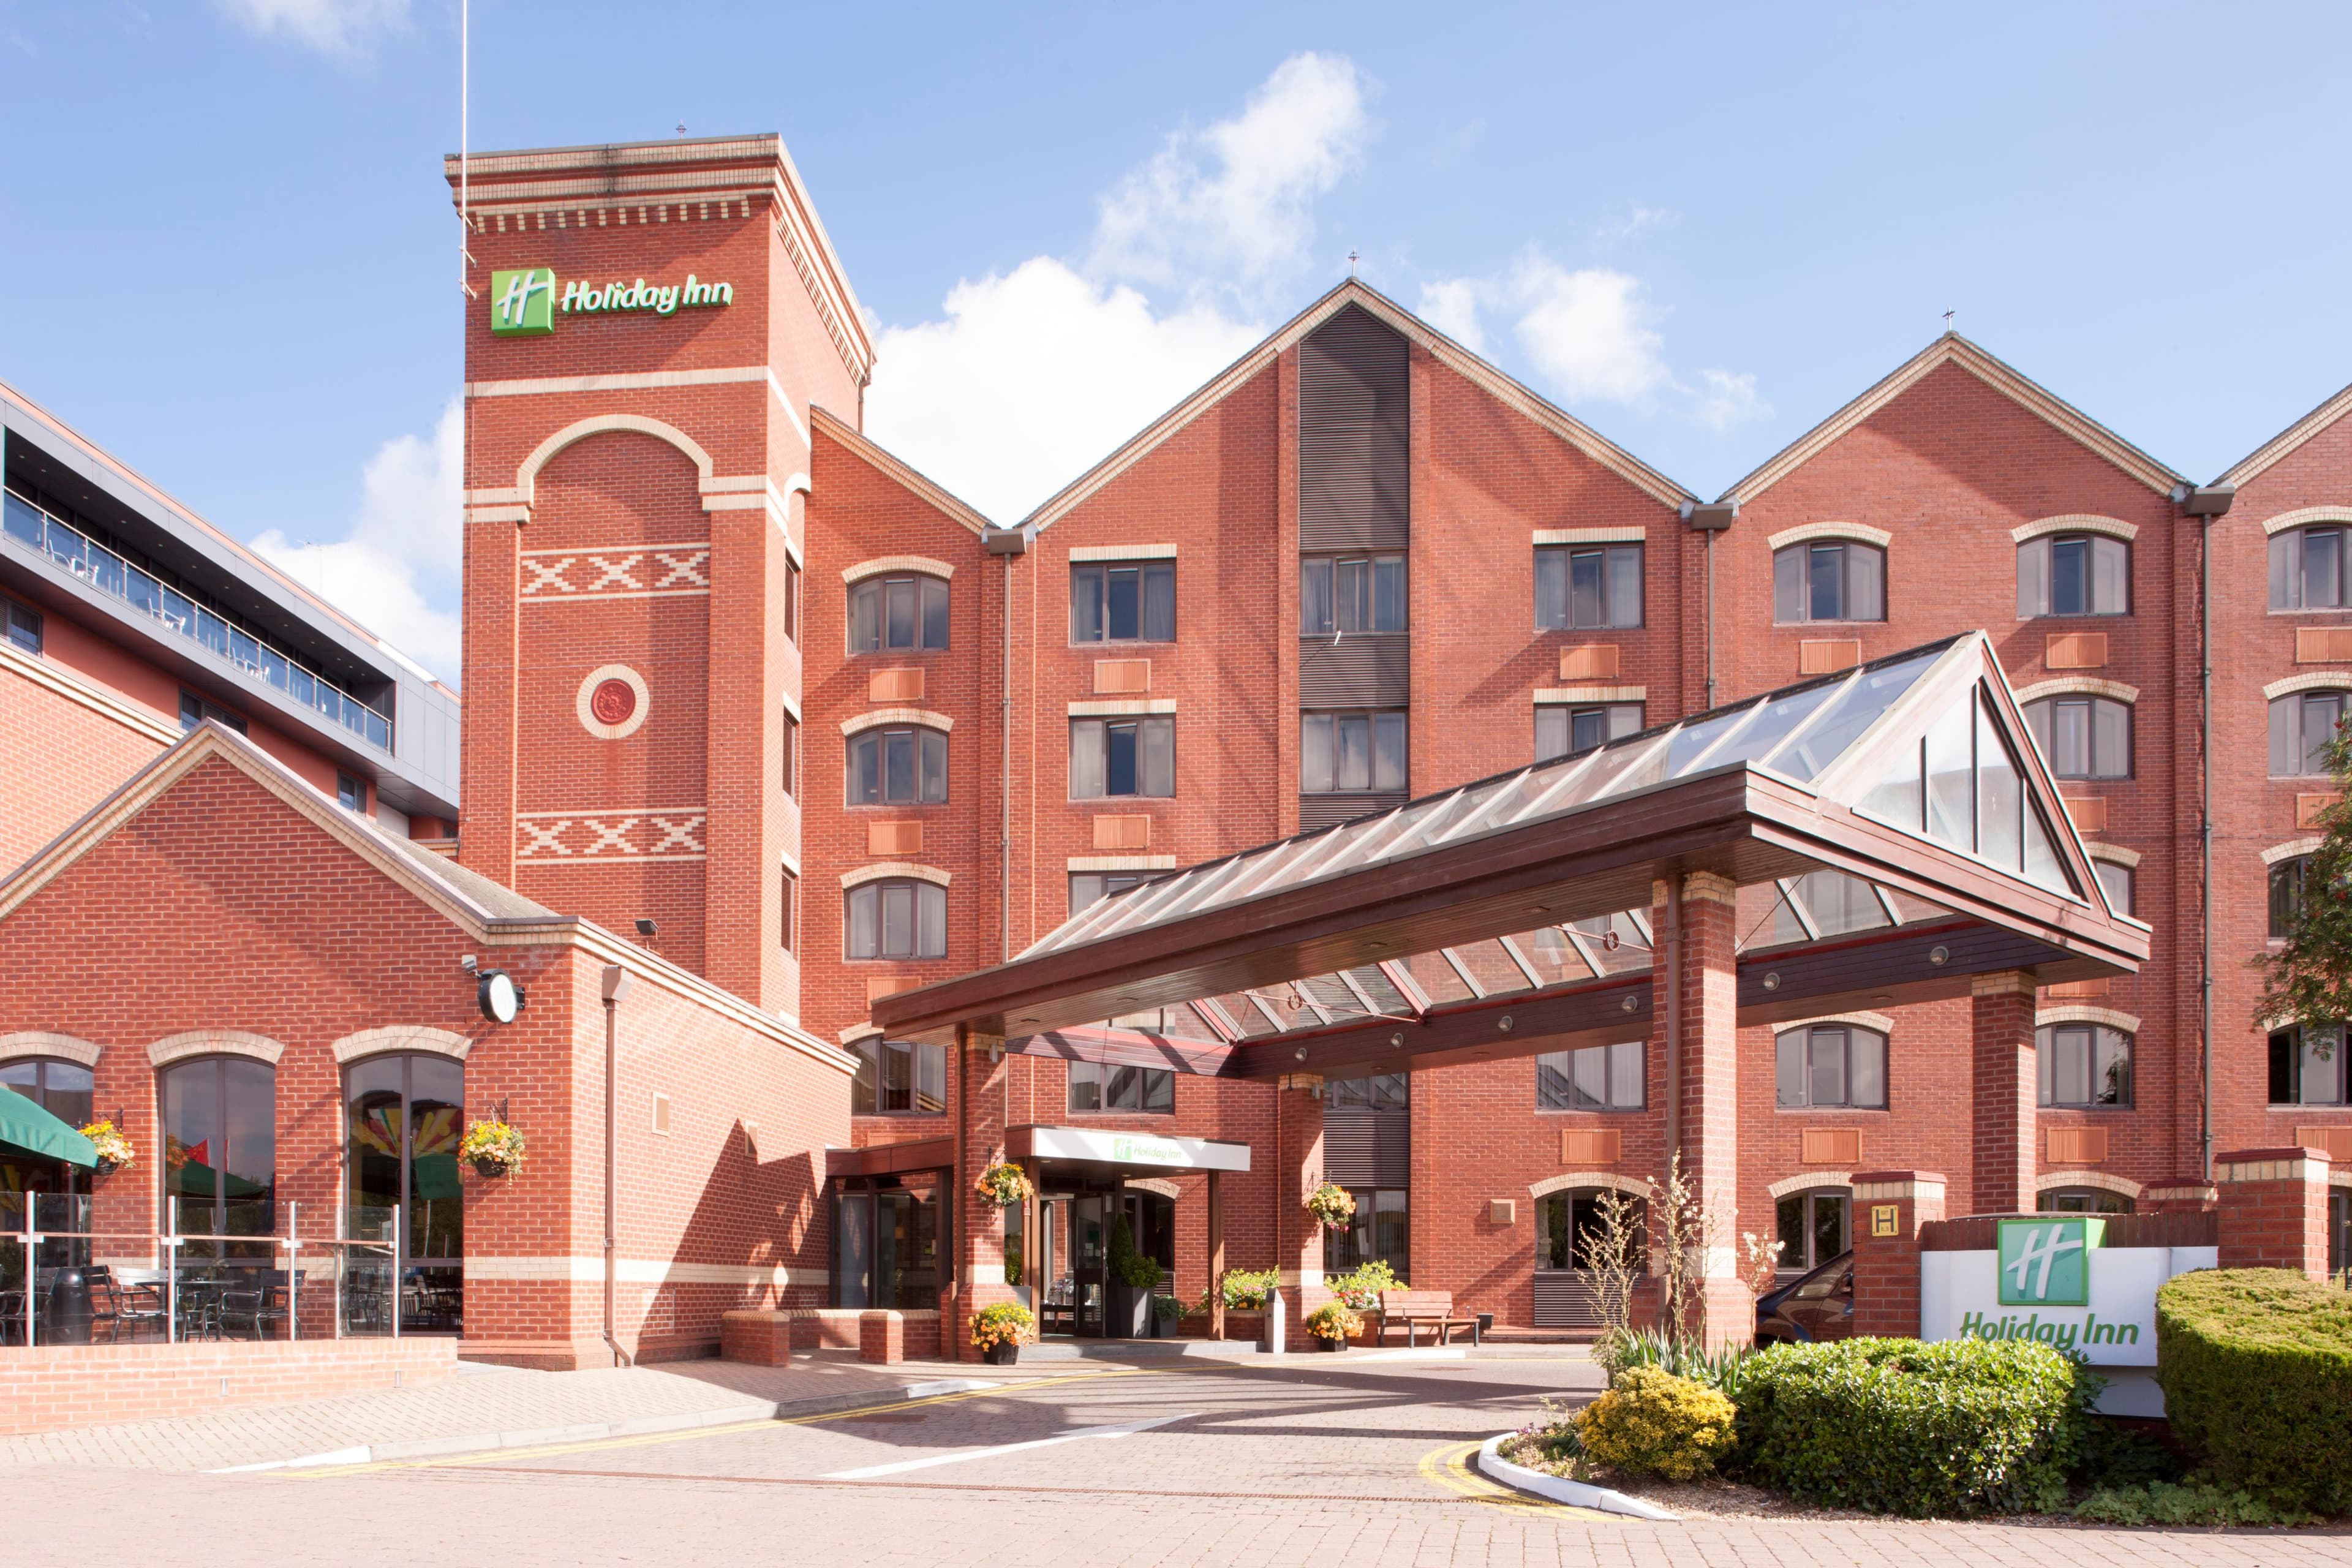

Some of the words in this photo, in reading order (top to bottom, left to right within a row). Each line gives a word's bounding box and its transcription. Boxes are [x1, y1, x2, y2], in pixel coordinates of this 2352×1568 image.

[560, 277, 680, 317] Holiday
[683, 274, 733, 305] Inn
[1134, 1144, 1167, 1161] Holiday
[1167, 1147, 1182, 1159] Inn
[1875, 1208, 1894, 1233] H
[1959, 1312, 2078, 1351] Holiday
[2082, 1313, 2139, 1344] Inn
